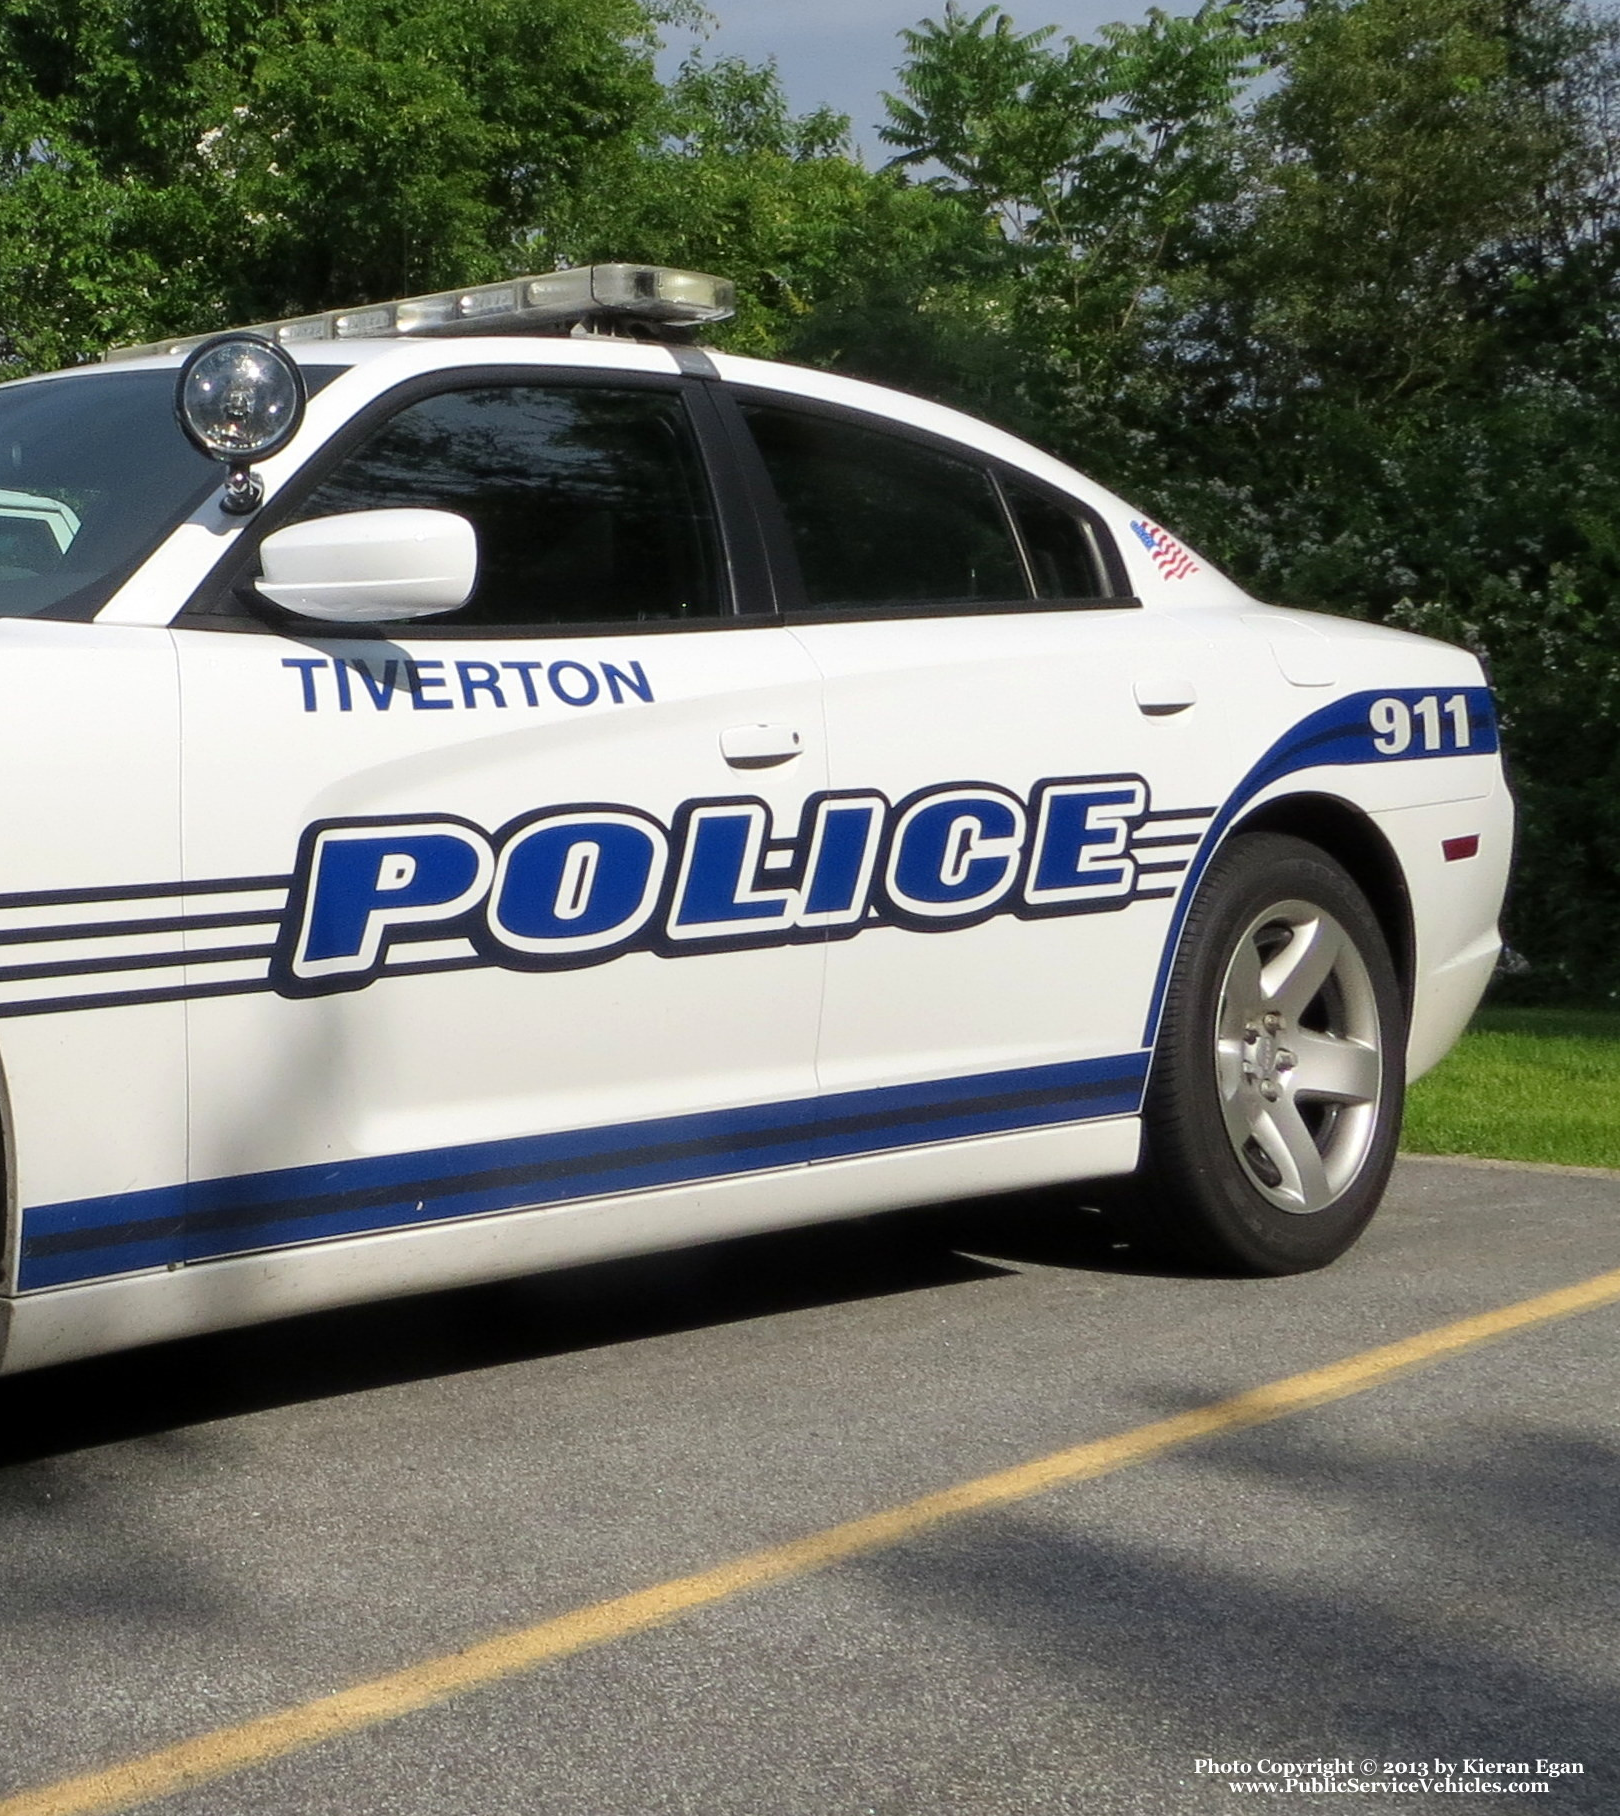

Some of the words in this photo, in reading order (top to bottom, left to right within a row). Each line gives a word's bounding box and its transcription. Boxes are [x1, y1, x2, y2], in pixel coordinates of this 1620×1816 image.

[282, 657, 655, 712] TIVERTON
[1369, 694, 1471, 755] 911
[280, 774, 1149, 997] POLICE
